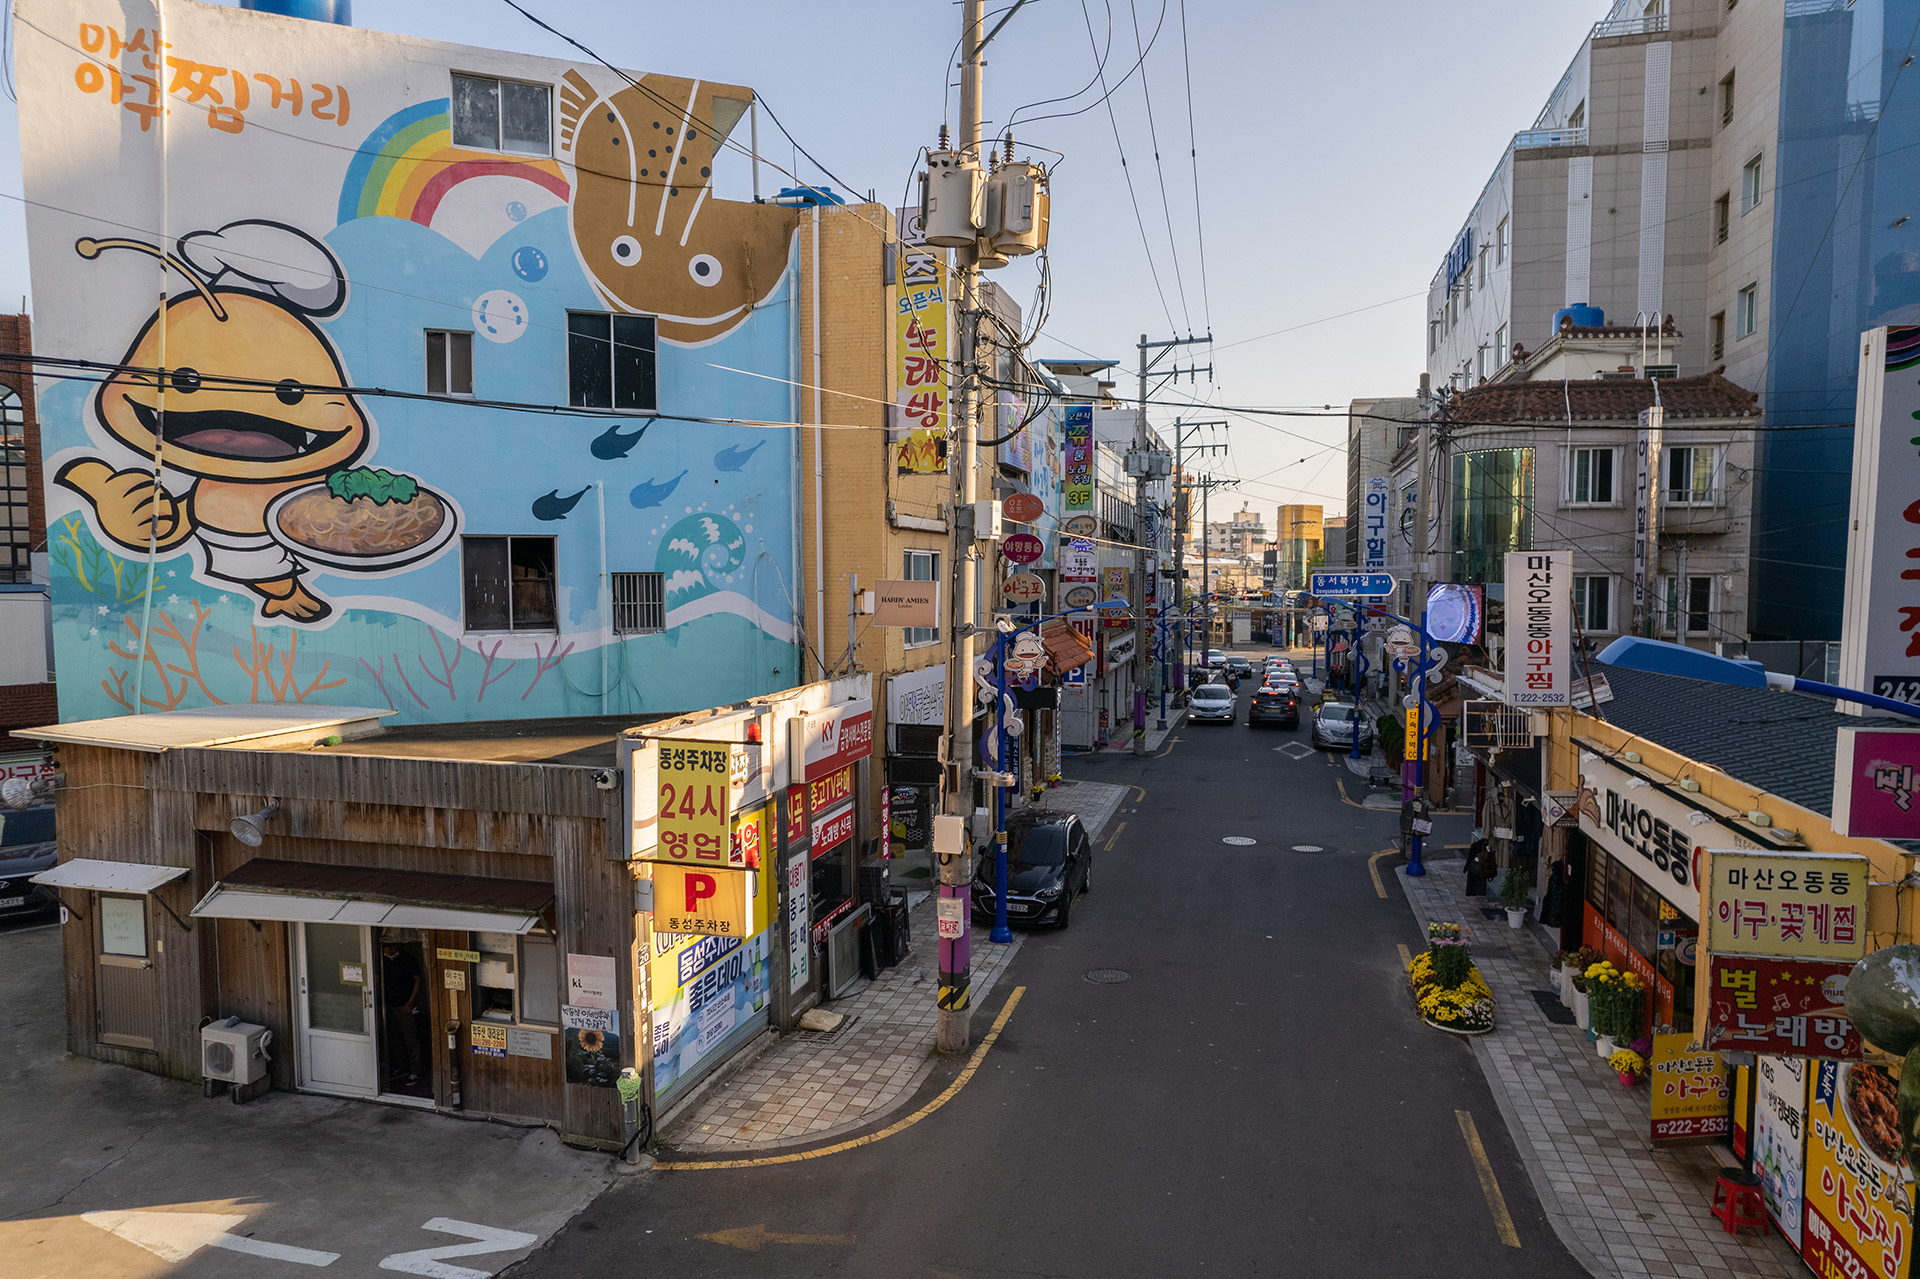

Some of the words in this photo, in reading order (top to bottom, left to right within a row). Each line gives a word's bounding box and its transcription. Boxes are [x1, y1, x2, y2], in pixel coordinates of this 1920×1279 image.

[79, 23, 172, 69] 마산
[899, 286, 944, 314] 오픈식
[903, 317, 944, 428] 노래방
[1068, 411, 1091, 421] 오픈식
[1068, 464, 1087, 474] 노래
[1073, 475, 1091, 486] 주점
[1069, 491, 1090, 505] 3F
[1635, 438, 1650, 602] 아구할매집
[1005, 541, 1042, 553] 야망통술
[1366, 491, 1388, 604] 아구할매
[1003, 581, 1041, 598] 아구포
[1317, 576, 1369, 587] 동서북17길
[1069, 667, 1081, 681] P
[1525, 639, 1553, 689] 아구찜
[1513, 692, 1565, 703] T.222-2532
[822, 719, 835, 743] KY
[1409, 711, 1417, 752] 단속구역
[660, 747, 727, 773] 동성주차장
[660, 783, 726, 826] 24시
[821, 821, 840, 847] 노래방
[840, 815, 852, 837] 신곡
[1606, 788, 1692, 886] 마산오동동
[660, 830, 721, 861] 영업
[789, 859, 807, 889] 대형TV
[1728, 867, 1851, 895] 마산오동동
[685, 873, 717, 912] P
[790, 892, 806, 922] 중고
[669, 917, 731, 932] 동성주차장
[1718, 898, 1857, 945] 아구·꽃게찜
[639, 953, 650, 964] 20
[690, 950, 743, 1014] 좋은데이
[1719, 967, 1758, 1010] 별
[1823, 988, 1845, 997] mus
[487, 1027, 505, 1042] 대리운전
[654, 1020, 670, 1042] 좋은
[1732, 1013, 1853, 1050] 노래방
[1657, 1056, 1716, 1074] 마산오동동
[1761, 1059, 1775, 1084] KBS
[1664, 1072, 1730, 1099] 아구찜
[1668, 1117, 1729, 1135] 222-2532
[1815, 1118, 1884, 1201] 마산오동동
[1808, 1207, 1832, 1251] 예약
[1821, 1165, 1904, 1279] 아구찜
